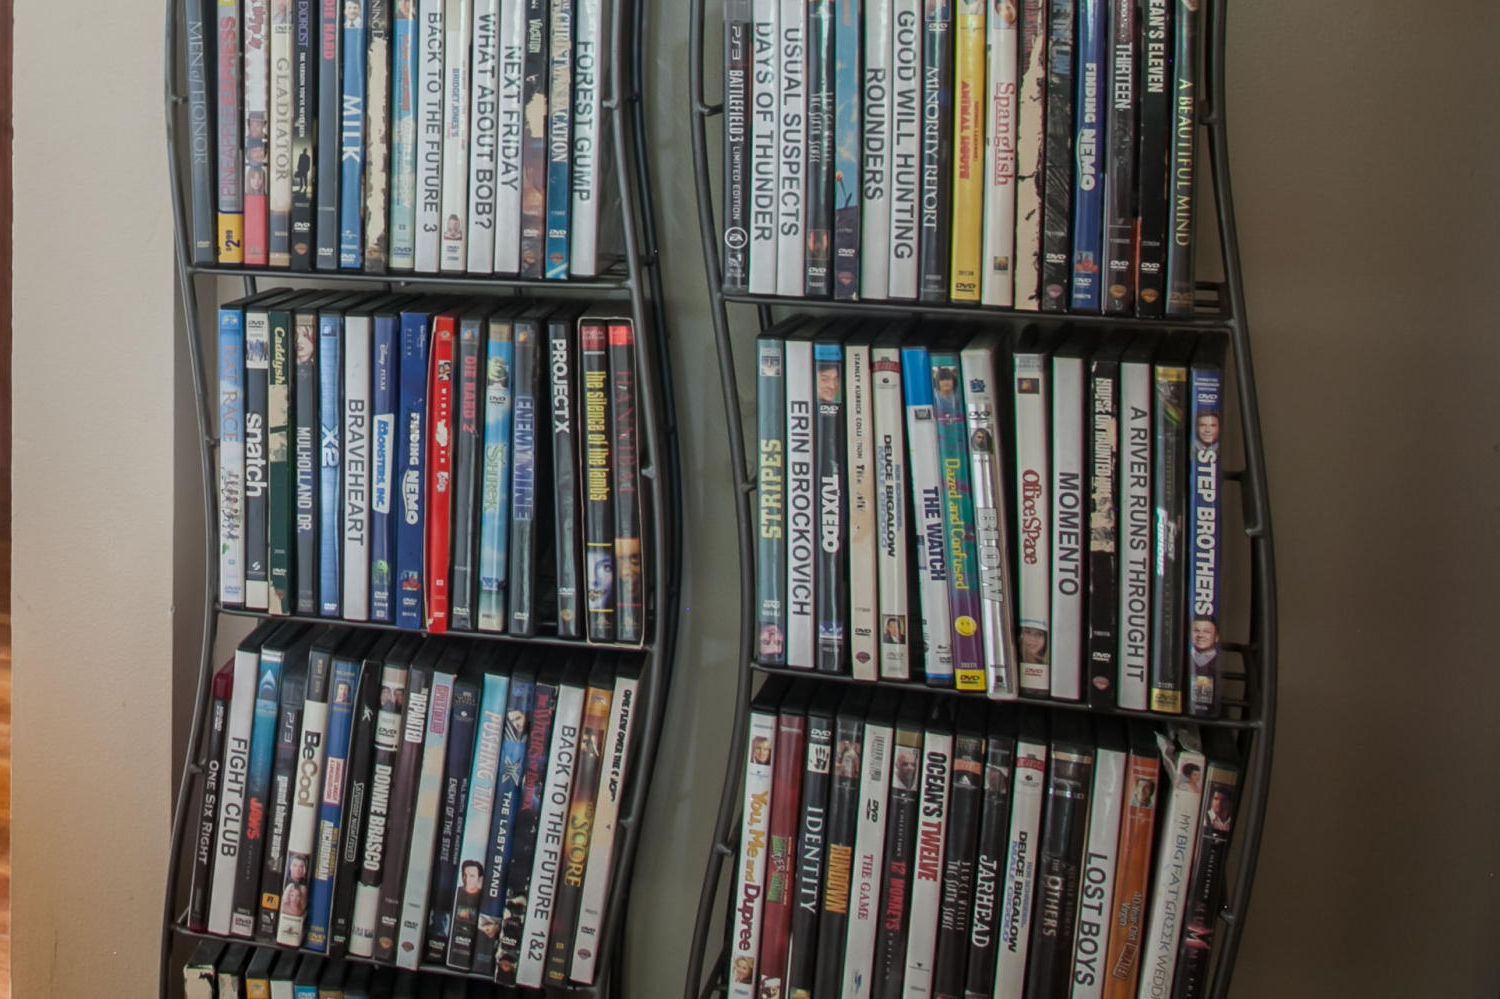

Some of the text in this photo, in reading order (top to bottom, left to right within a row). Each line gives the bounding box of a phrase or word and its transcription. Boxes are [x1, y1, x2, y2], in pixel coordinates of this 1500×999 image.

[298, 1, 308, 47] EXORCIST
[323, 23, 334, 60] HARD
[1115, 42, 1132, 109] THIRTEEN
[1147, 43, 1164, 92] ELEVEN
[275, 58, 288, 182] GLADIATOR
[342, 95, 360, 163] MILK
[424, 13, 441, 233] BACK TO THE FUTURE 3
[475, 13, 495, 229] WHAT ABOUT BOB?
[501, 46, 521, 190] NEXT FRIDAY
[573, 41, 593, 201] FOREST GUMP
[754, 22, 774, 240] DAYS OF THUNDER
[781, 27, 801, 236] USUAL SUSPECTS
[864, 68, 886, 200] ROUNDERS
[894, 10, 916, 259] GOOD WILL HUNTING
[924, 66, 940, 231] MINORITY REPORT
[994, 82, 1015, 186] Spanglish
[1078, 63, 1096, 191] FINDING NEMO
[1176, 78, 1192, 245] A BEAUTIFUL MIND
[223, 344, 238, 441] RAT RACE
[552, 339, 569, 433] PROJECT X
[246, 413, 266, 496] snatch
[296, 427, 311, 533] MULHOLLAND DR.
[322, 424, 339, 468] X2
[347, 399, 363, 545] BRAVEHEART
[761, 439, 781, 538] STRIPES
[883, 435, 896, 557] DEUCE BIGALOW
[790, 400, 811, 615] ERIN BROCKOVICH
[822, 475, 839, 553] TUXEDO
[923, 487, 946, 581] THE WATCH
[944, 458, 968, 589] Dazed and Confused
[977, 507, 1003, 602] BLOW
[1059, 471, 1078, 596] MOMENTO
[1127, 406, 1147, 682] A RIVER RUNS THROUGH IT
[1195, 449, 1216, 615] STEP BROTHERS
[405, 692, 426, 743] DEPARTED
[474, 711, 501, 813] PUSHING TIN
[198, 760, 219, 864] ONE SIX RIGHT
[221, 737, 248, 857] FIGHT CLUB
[247, 797, 263, 839] JAWS
[317, 820, 334, 881] ANCHORMAN
[363, 764, 391, 871] DONNIE BRASCO
[488, 791, 512, 898] THE LAST STAND
[528, 725, 576, 960] BACK TO THE FUTURE 1&2
[917, 752, 947, 882] OCEAN'S TWELVE
[564, 816, 590, 887] SCORE
[737, 791, 768, 951] You, Me and Dupree
[800, 805, 823, 914] IDENTITY
[825, 844, 852, 914] RUNDOWN
[857, 800, 879, 920] DVD THE GAME
[885, 862, 906, 930] 12 MONKEYS
[972, 855, 996, 947] JARHEAD
[1008, 831, 1028, 952] DEUCE BIGALOW
[1042, 875, 1062, 936] OTHERS
[1074, 852, 1108, 987] LOST BOYS
